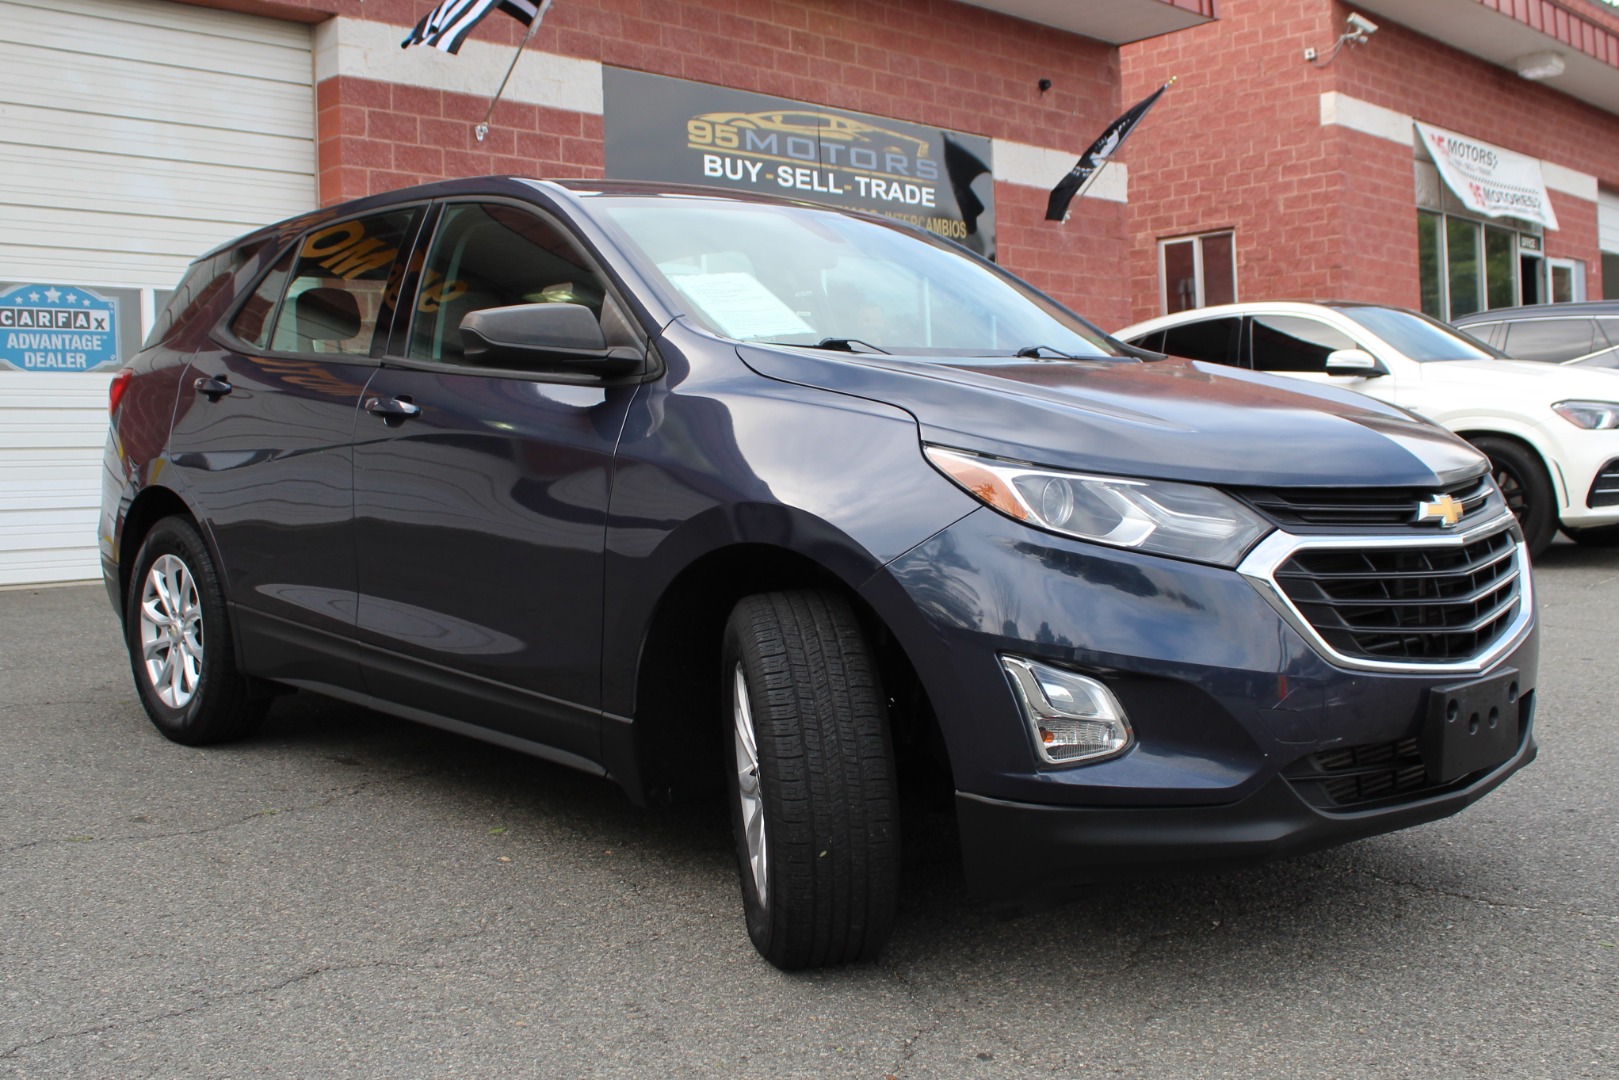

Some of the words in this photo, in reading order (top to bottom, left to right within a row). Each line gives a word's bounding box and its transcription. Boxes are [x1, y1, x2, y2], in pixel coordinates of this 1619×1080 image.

[687, 119, 739, 149] 95
[745, 129, 939, 180] MOTORS
[703, 153, 764, 183] BUY
[776, 165, 844, 195] SELL
[854, 175, 937, 208] TRADE
[0, 309, 107, 331] CARFAX
[7, 333, 103, 351] ADVANTAGE
[24, 351, 88, 369] DEALER
